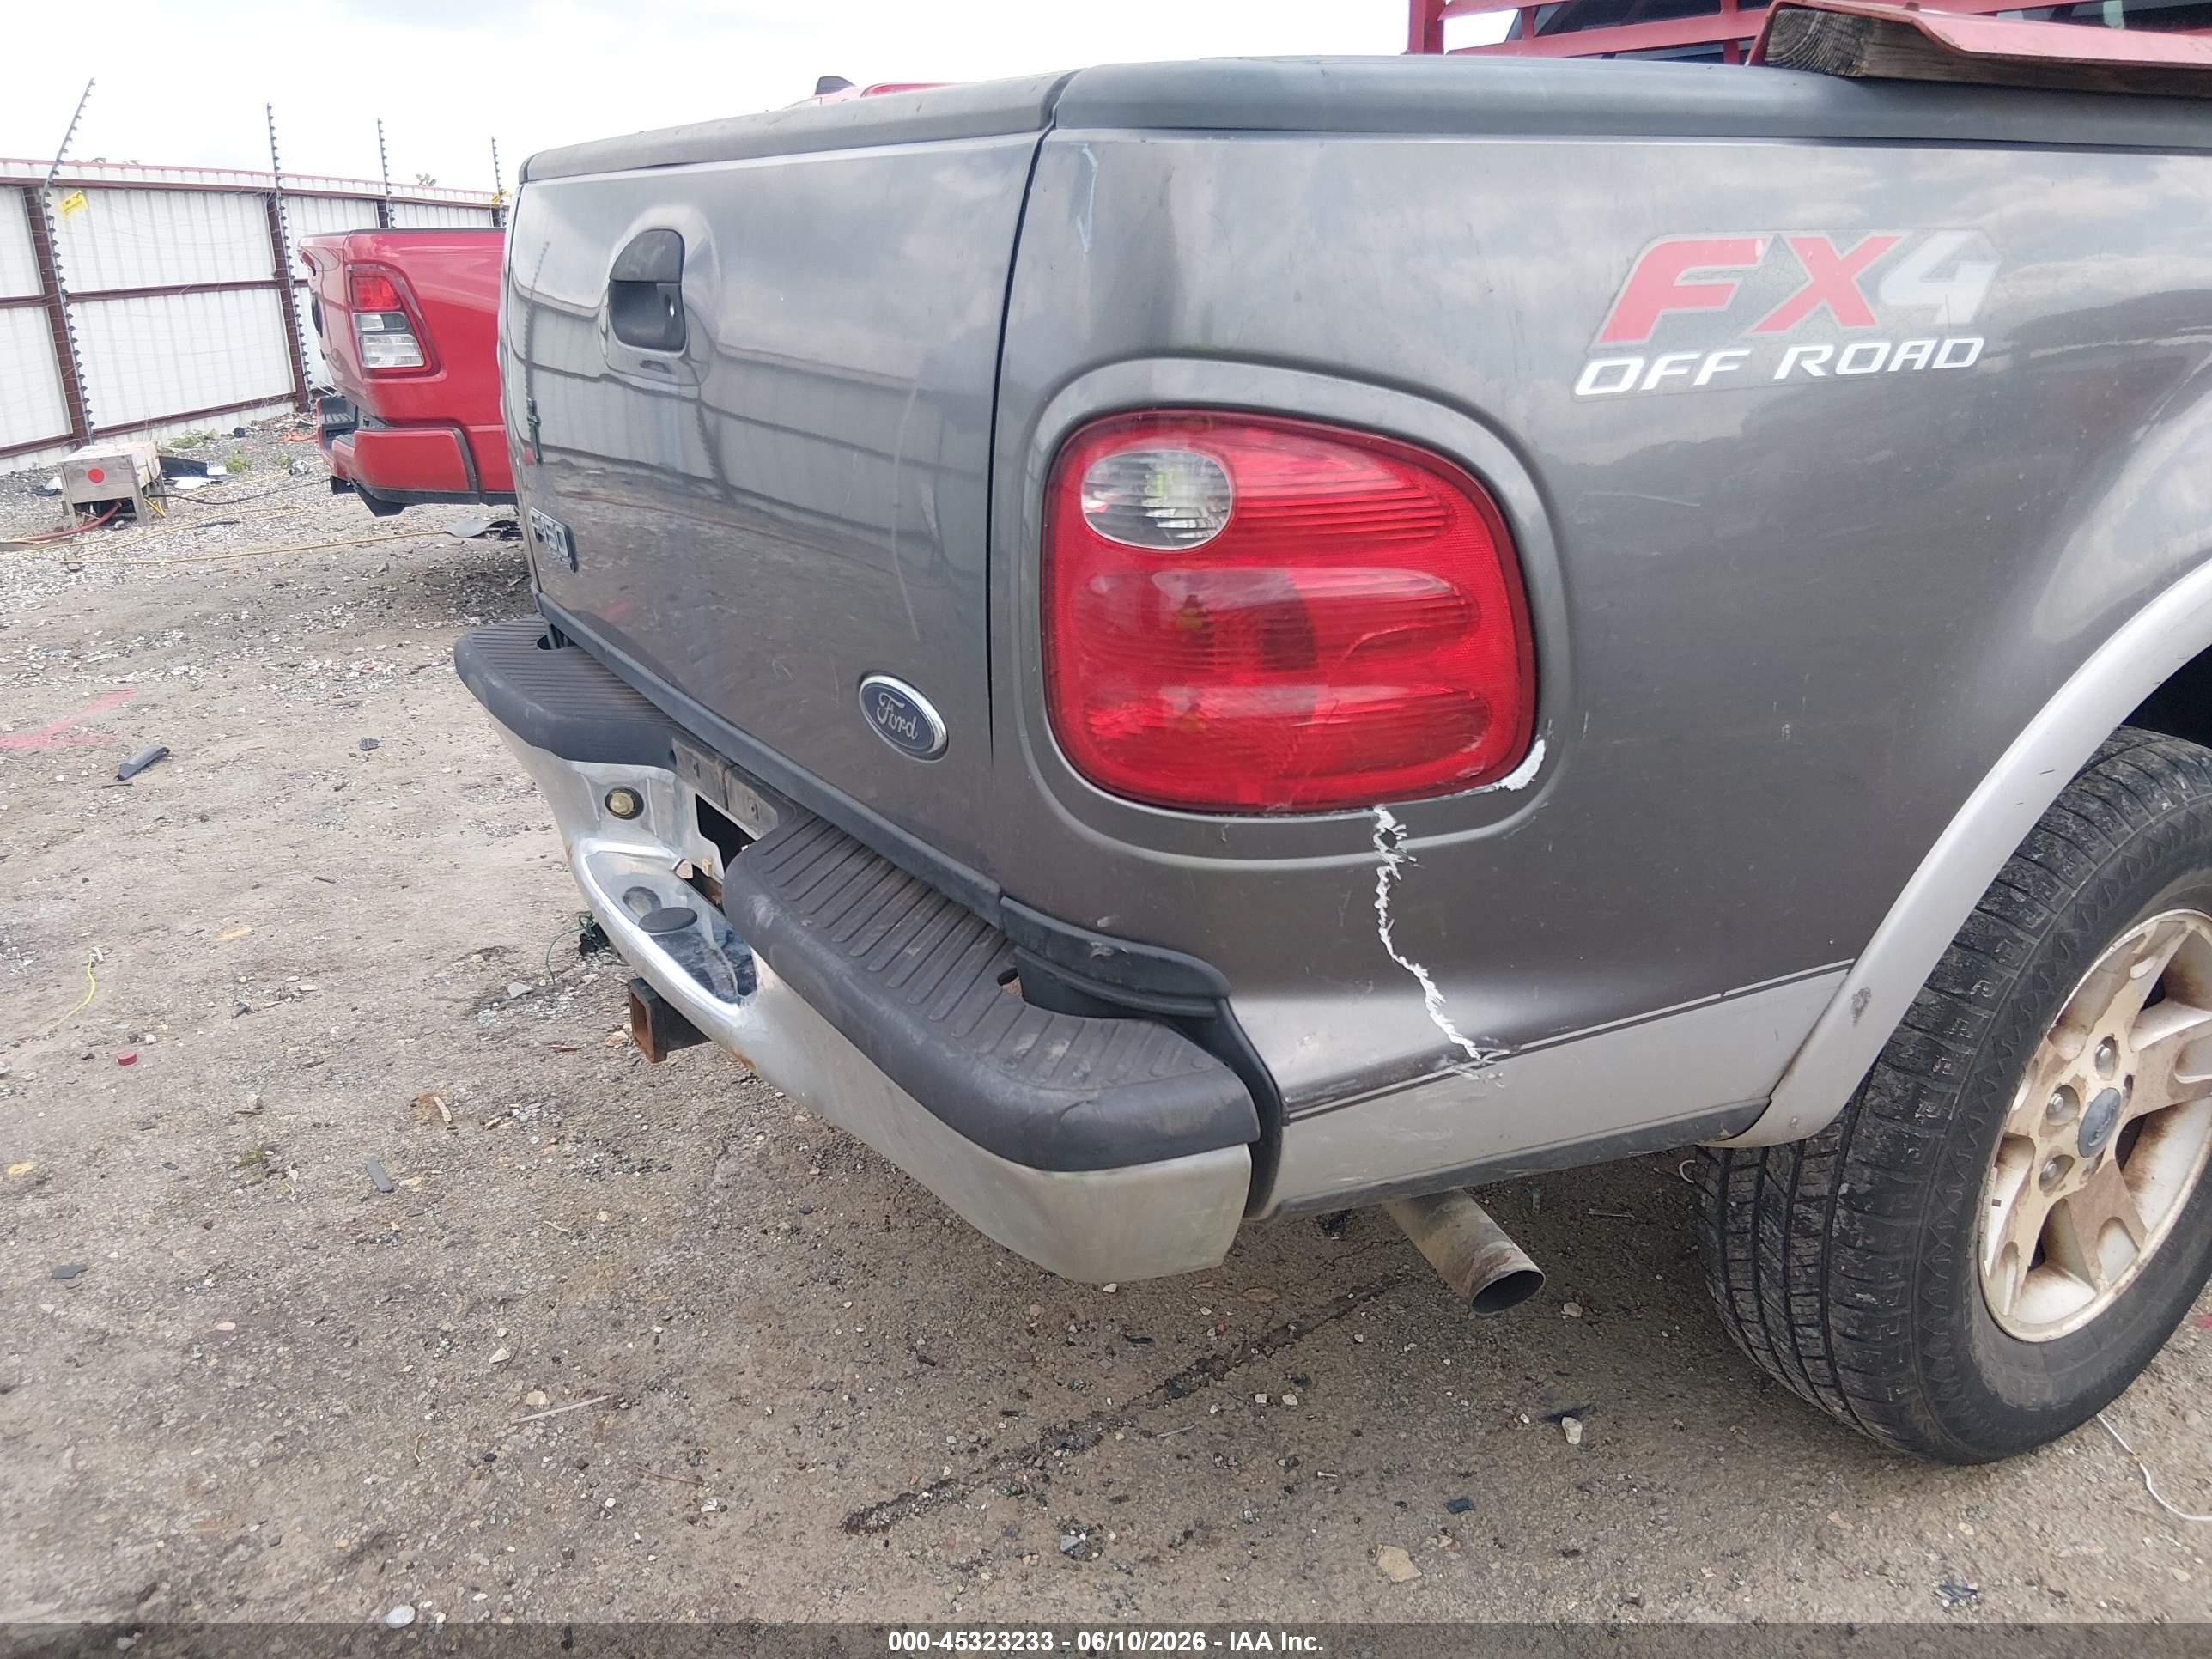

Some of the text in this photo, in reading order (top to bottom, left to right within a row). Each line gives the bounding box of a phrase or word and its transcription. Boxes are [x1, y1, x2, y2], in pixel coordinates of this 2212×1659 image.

[1592, 231, 2001, 343] FX4
[1574, 337, 1986, 397] OFF ROAD
[876, 691, 919, 740] Ford
